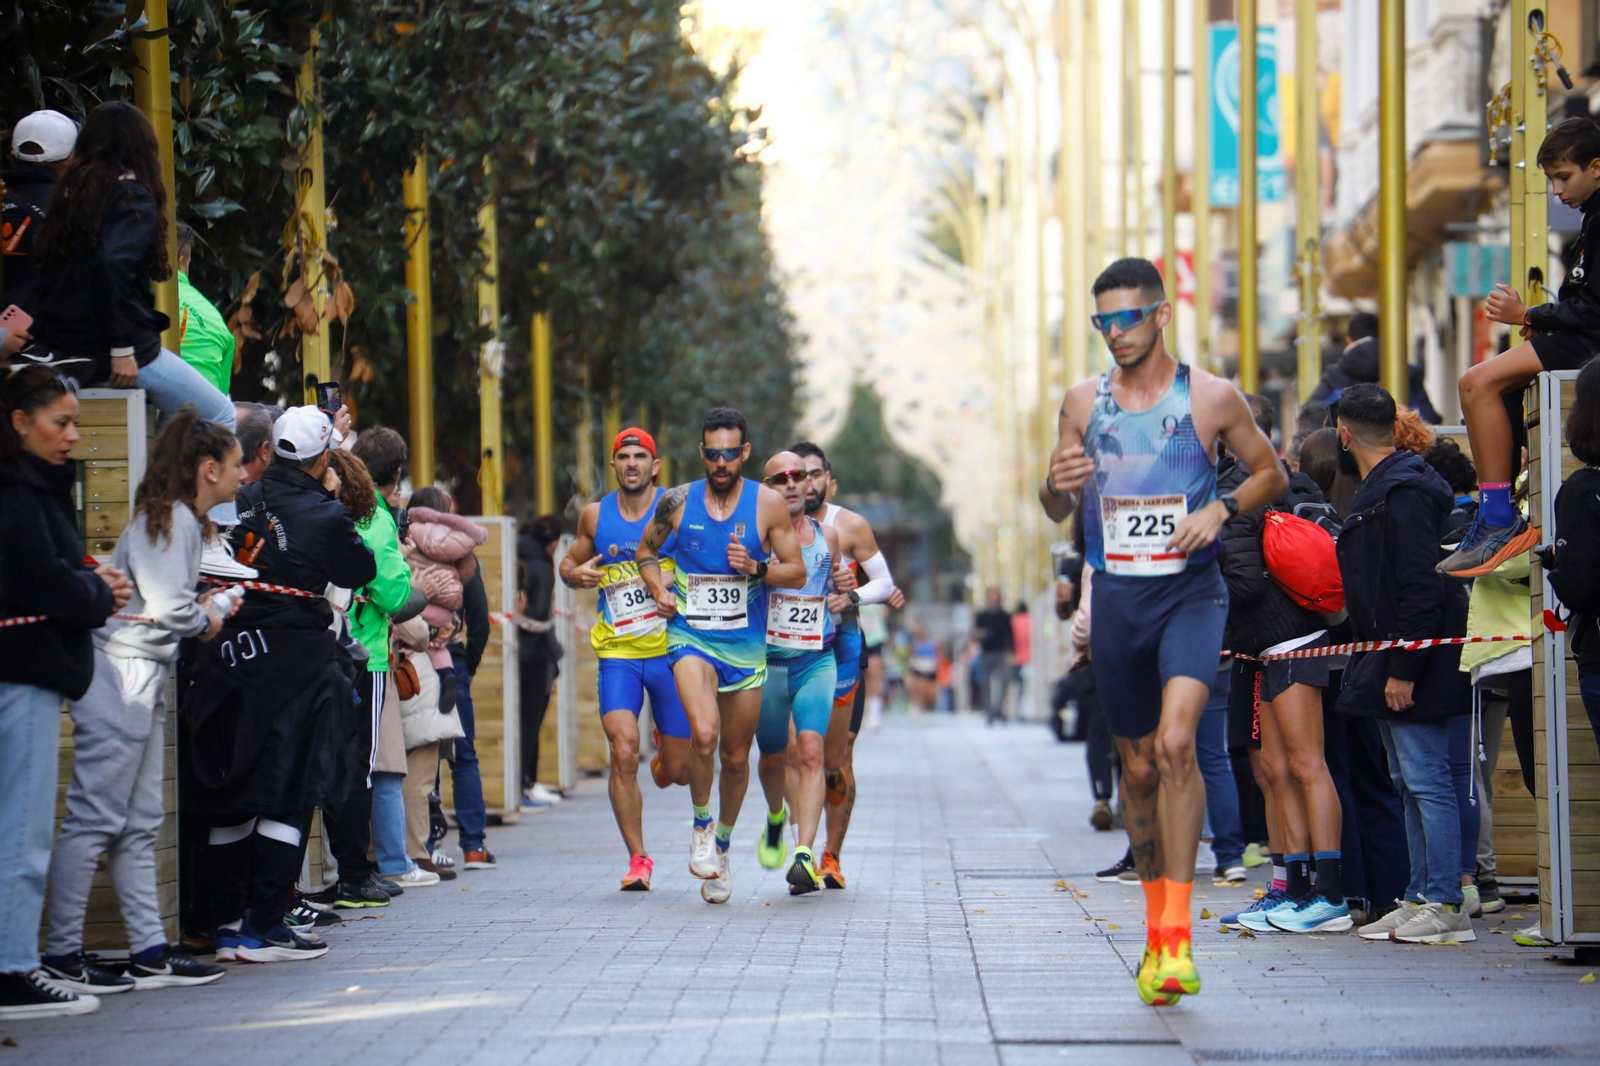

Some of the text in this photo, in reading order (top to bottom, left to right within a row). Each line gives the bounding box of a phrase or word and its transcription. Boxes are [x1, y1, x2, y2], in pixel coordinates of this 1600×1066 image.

[1127, 514, 1175, 537] 225
[623, 589, 654, 608] 384
[707, 588, 740, 604] 339
[788, 607, 818, 624] 224
